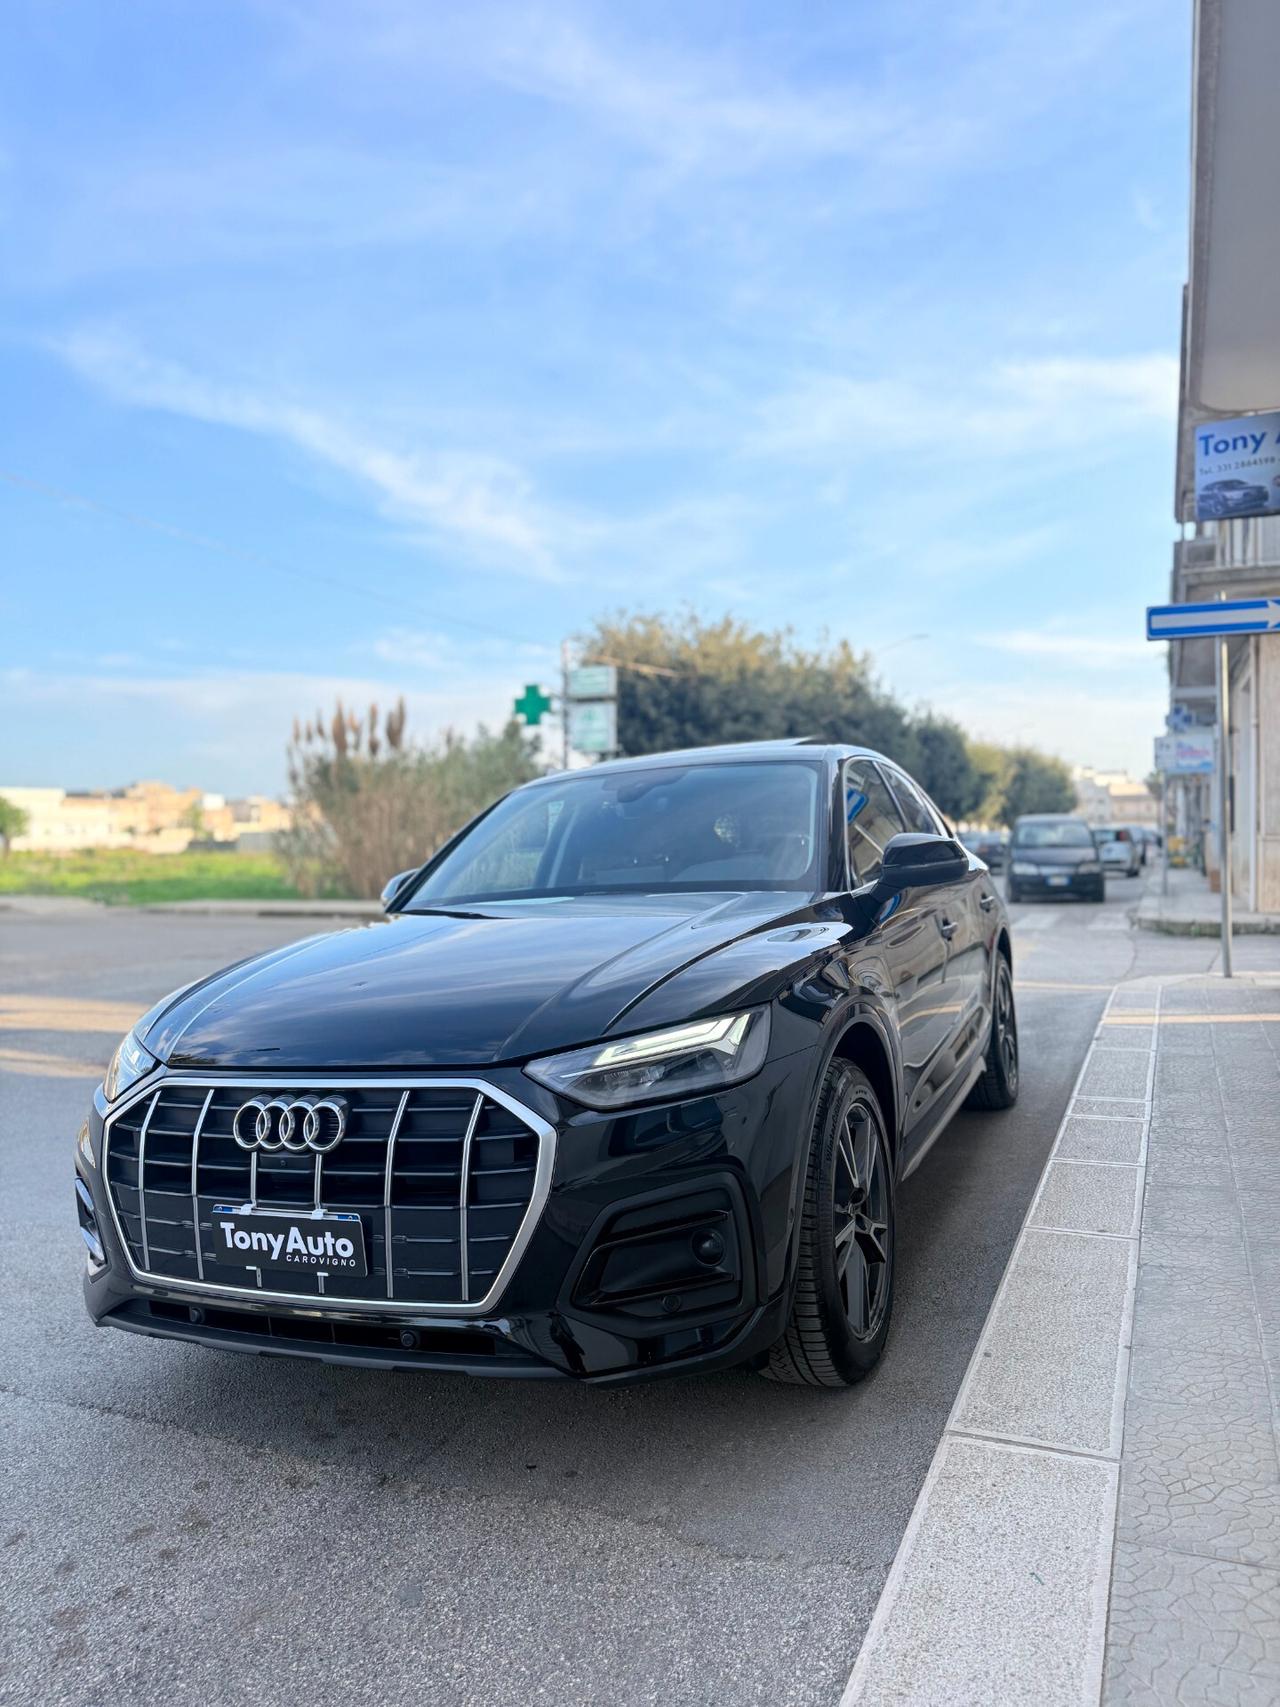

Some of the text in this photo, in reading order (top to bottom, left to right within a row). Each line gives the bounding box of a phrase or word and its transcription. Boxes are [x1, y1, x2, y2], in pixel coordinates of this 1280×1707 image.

[1199, 432, 1266, 456] Tony
[219, 1221, 354, 1260] TonyAuto
[286, 1254, 356, 1267] CAROVIGNO
